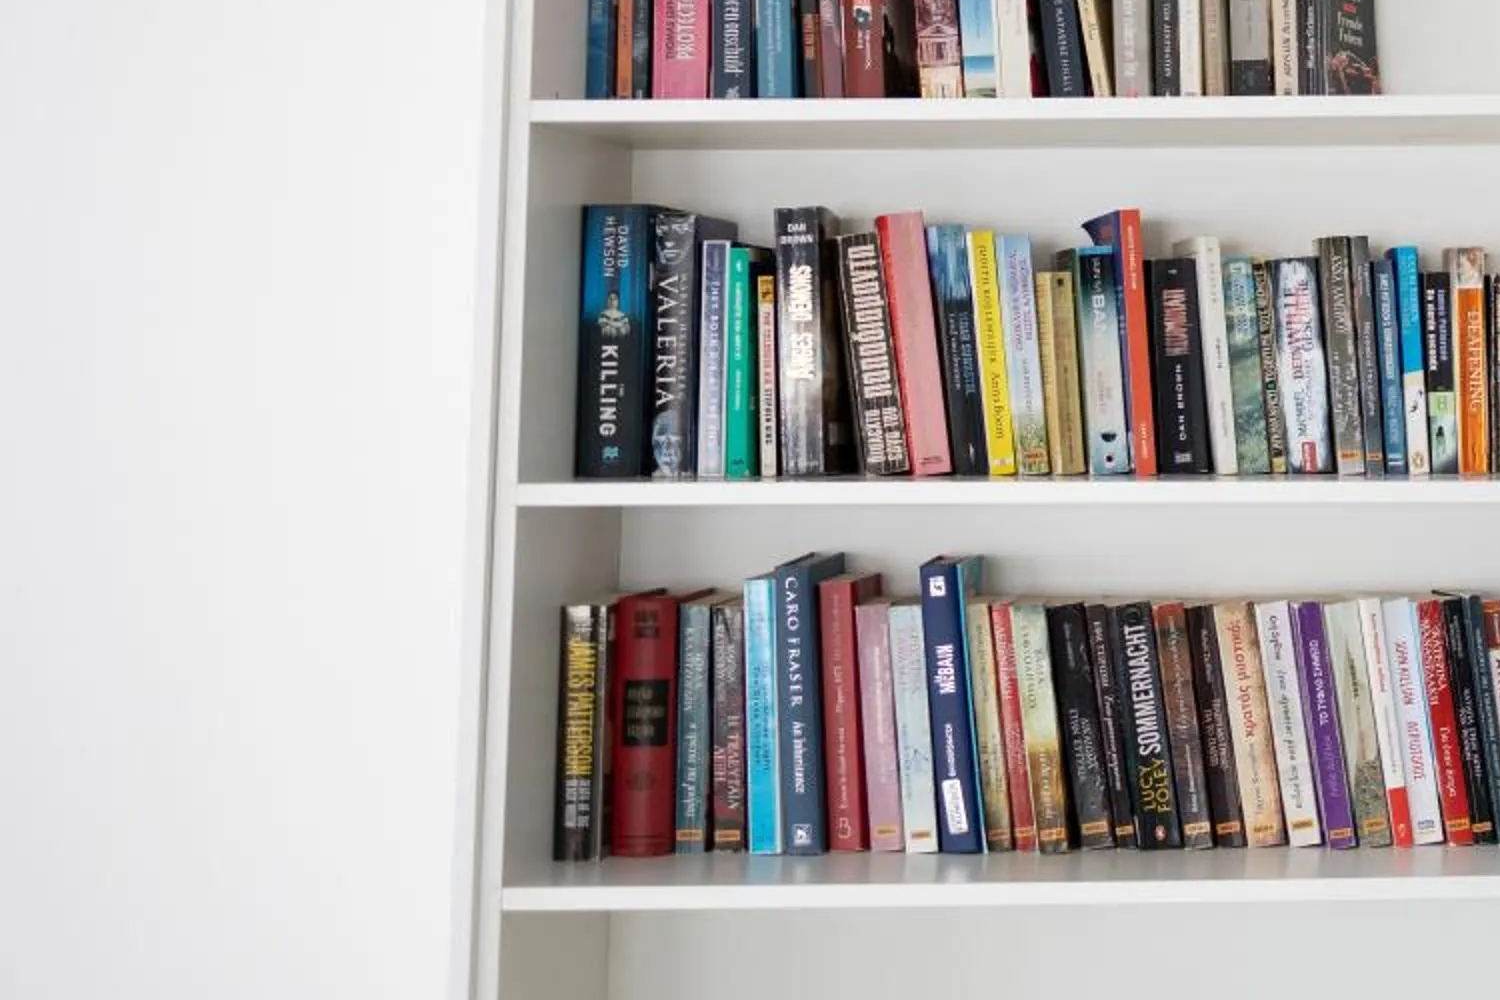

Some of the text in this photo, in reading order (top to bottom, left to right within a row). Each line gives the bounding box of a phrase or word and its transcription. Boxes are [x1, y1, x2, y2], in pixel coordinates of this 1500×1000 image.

[603, 216, 617, 277] HEWSON
[617, 225, 630, 268] DAVID
[977, 245, 991, 285] JUDITH
[655, 275, 679, 408] VALERIA
[1467, 311, 1483, 412] DEAFENING
[598, 345, 619, 437] KILLING
[990, 372, 1003, 404] Anna
[1174, 364, 1187, 441] DAN BROWN
[993, 405, 1006, 440] Boom
[568, 637, 597, 687] JAMES
[784, 576, 808, 794] CARO FRASER An Inheritance
[1123, 623, 1162, 757] SOMMERNACHT
[564, 690, 595, 776] PATTERSON
[1139, 765, 1156, 812] LUCY
[1151, 758, 1172, 813] FOLEY
